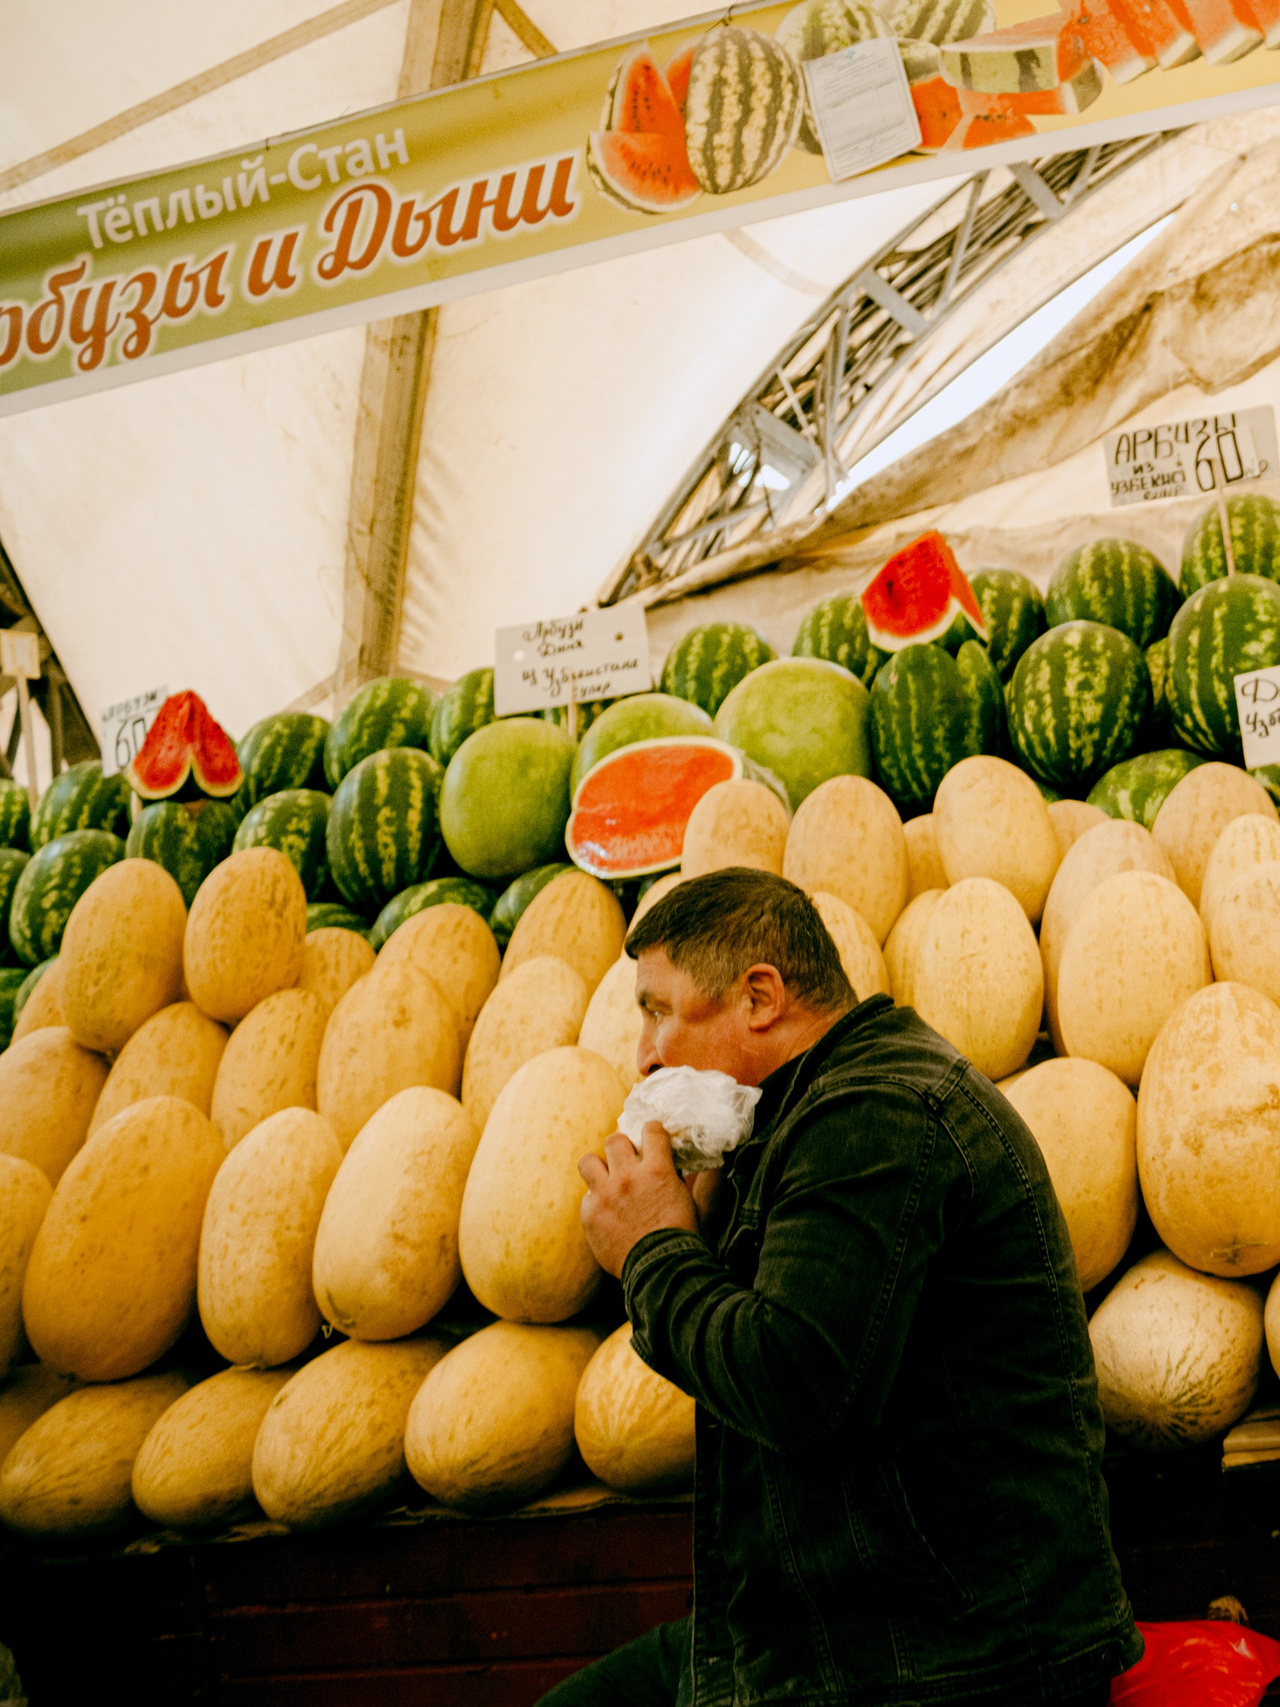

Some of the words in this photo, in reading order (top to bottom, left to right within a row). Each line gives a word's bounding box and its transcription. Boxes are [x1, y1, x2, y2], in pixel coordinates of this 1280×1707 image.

[76, 128, 409, 250] Тёплый-Стан
[248, 231, 299, 297] и
[317, 156, 575, 281] Дыни
[1195, 430, 1244, 492] 60
